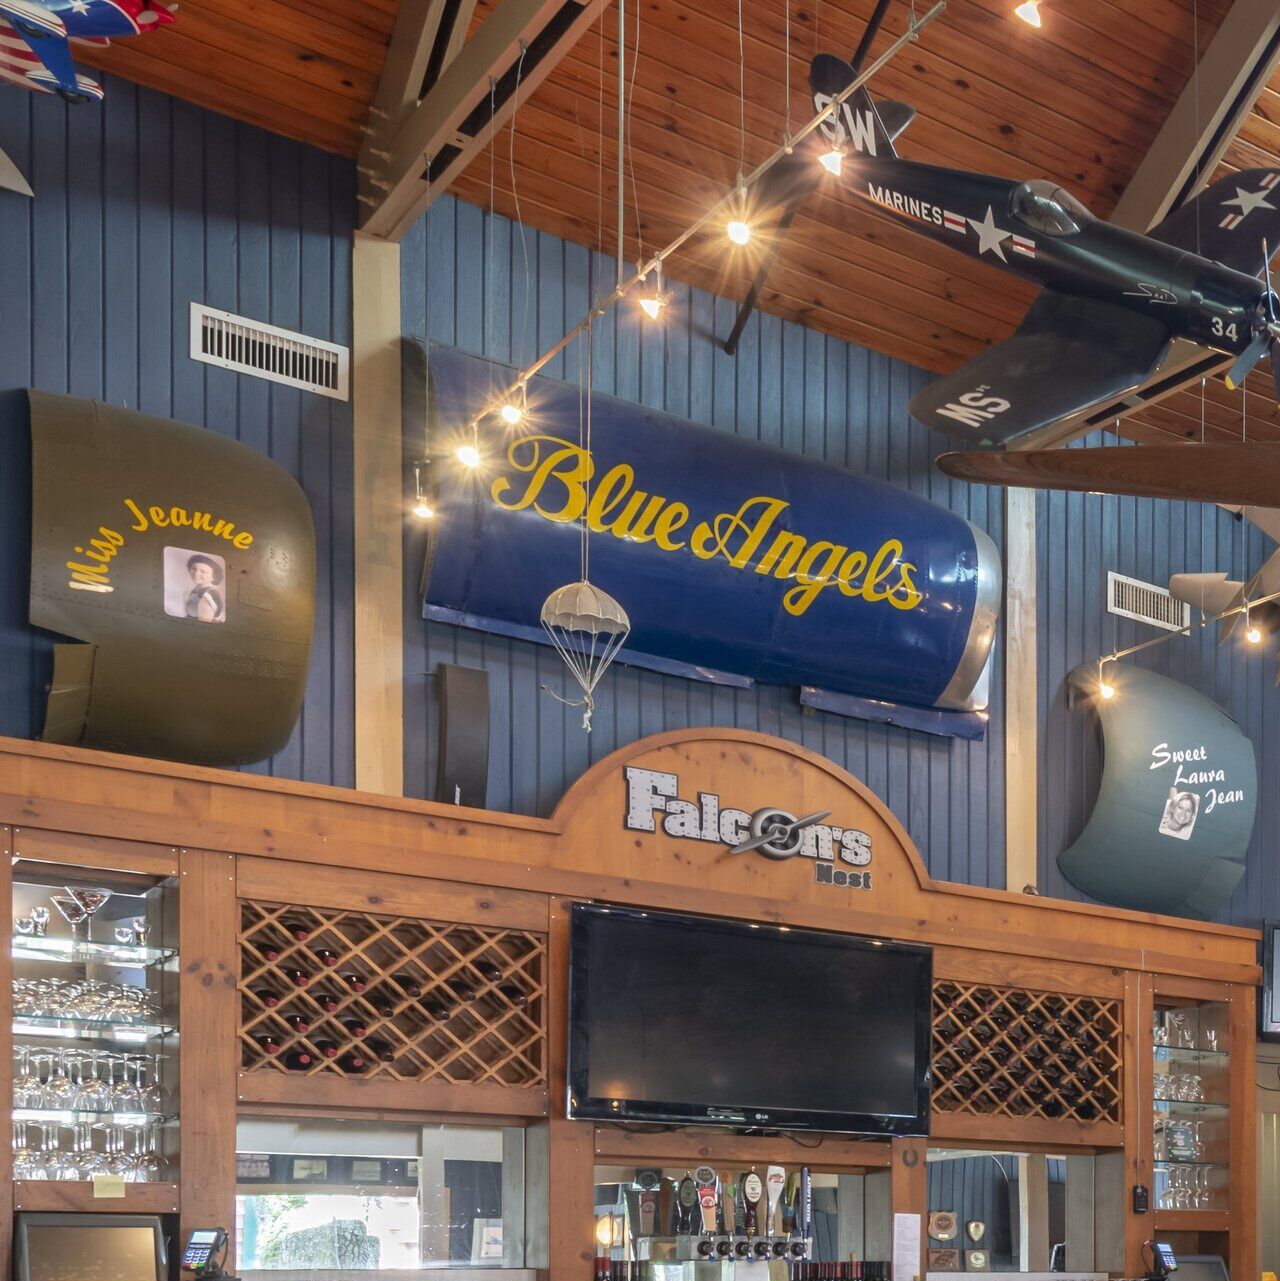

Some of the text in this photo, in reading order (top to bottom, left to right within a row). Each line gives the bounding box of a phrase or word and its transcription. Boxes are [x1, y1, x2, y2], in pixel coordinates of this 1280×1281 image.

[814, 92, 877, 157] SW
[868, 182, 943, 226] MARINES
[1211, 316, 1239, 342] 34
[491, 435, 923, 616] Blue Angels
[66, 499, 254, 593] Miss Jeanne
[1149, 743, 1208, 770] Sweet
[1174, 764, 1225, 786] Laura
[1205, 789, 1244, 814] Jean
[815, 861, 873, 890] Nest
